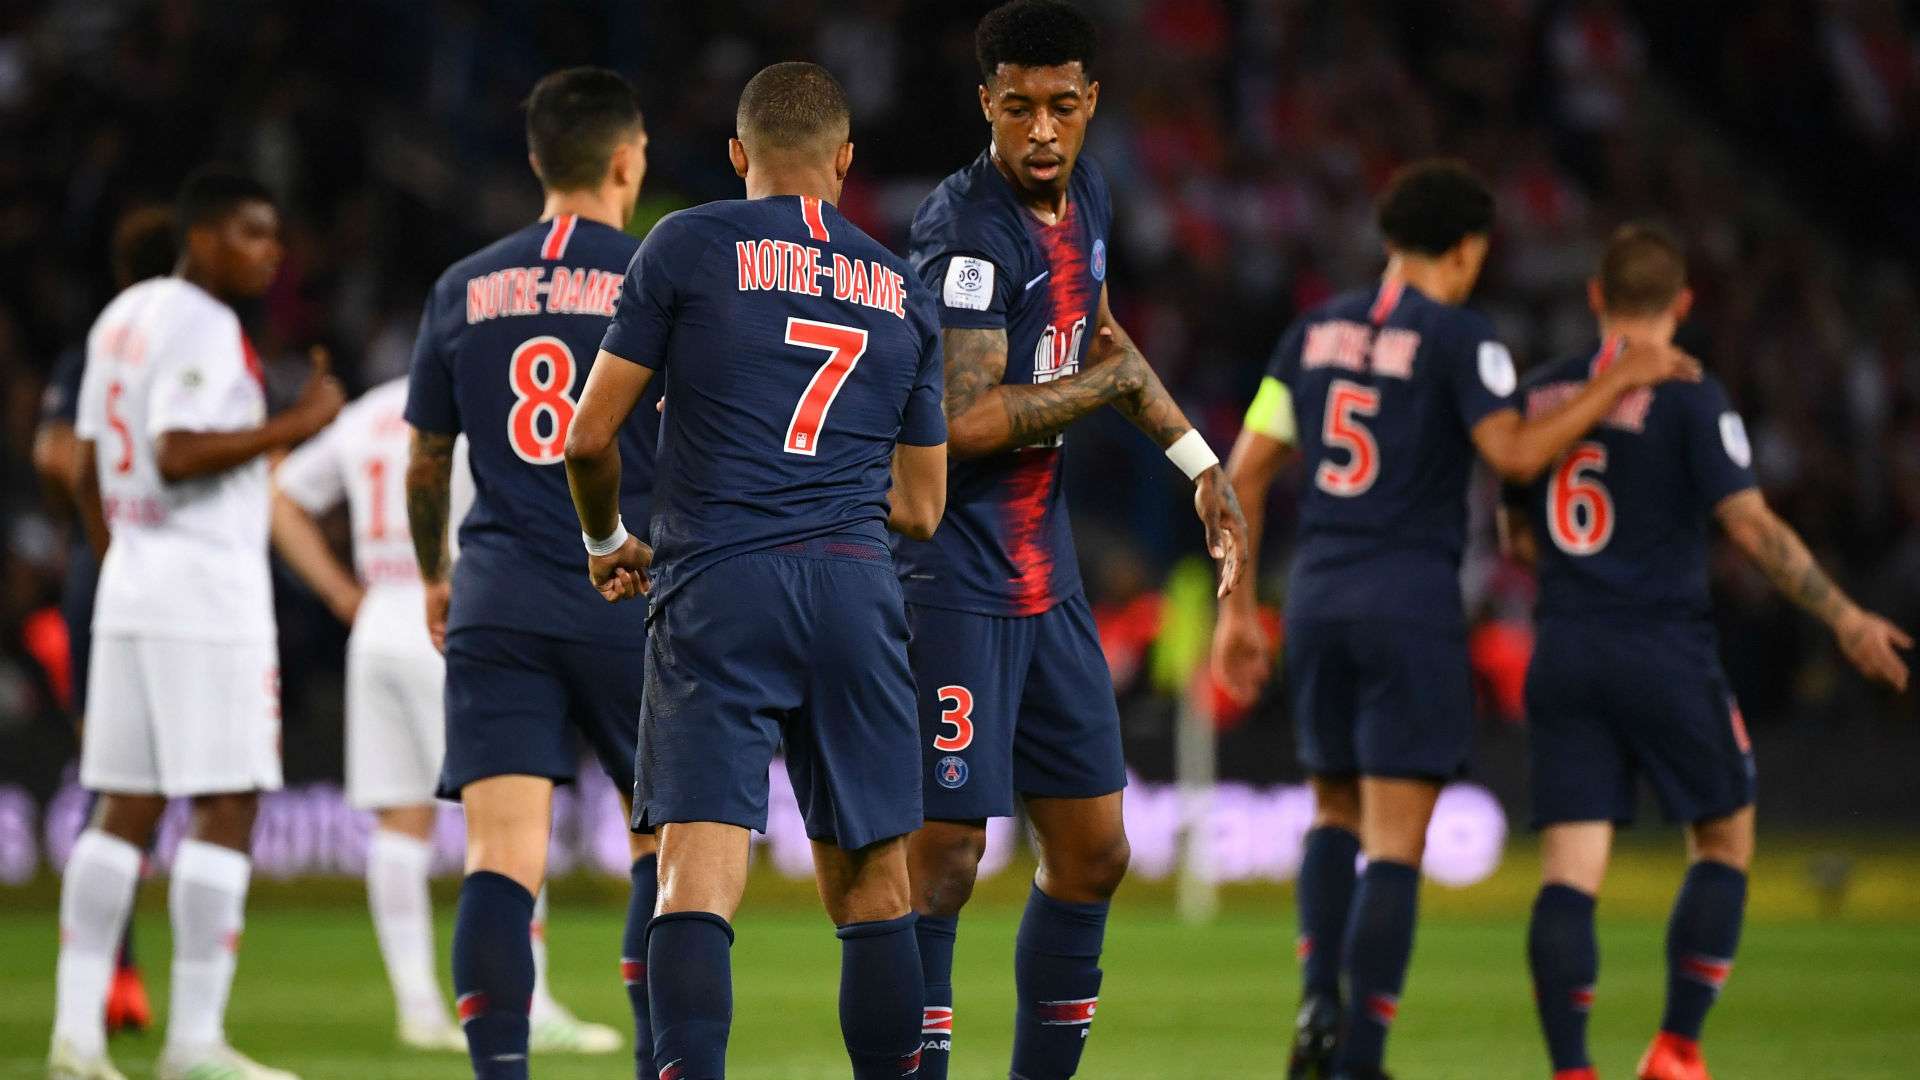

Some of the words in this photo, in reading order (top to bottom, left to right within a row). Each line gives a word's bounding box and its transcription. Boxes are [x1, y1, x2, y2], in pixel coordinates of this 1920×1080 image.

[466, 266, 626, 325] NOTRE-DAME
[736, 238, 908, 320] NOTRE-DAME
[105, 382, 136, 476] 5
[507, 335, 577, 466] 8
[783, 316, 869, 457] 7
[1315, 379, 1381, 498] 5
[1547, 442, 1615, 557] 6
[933, 685, 974, 752] 3
